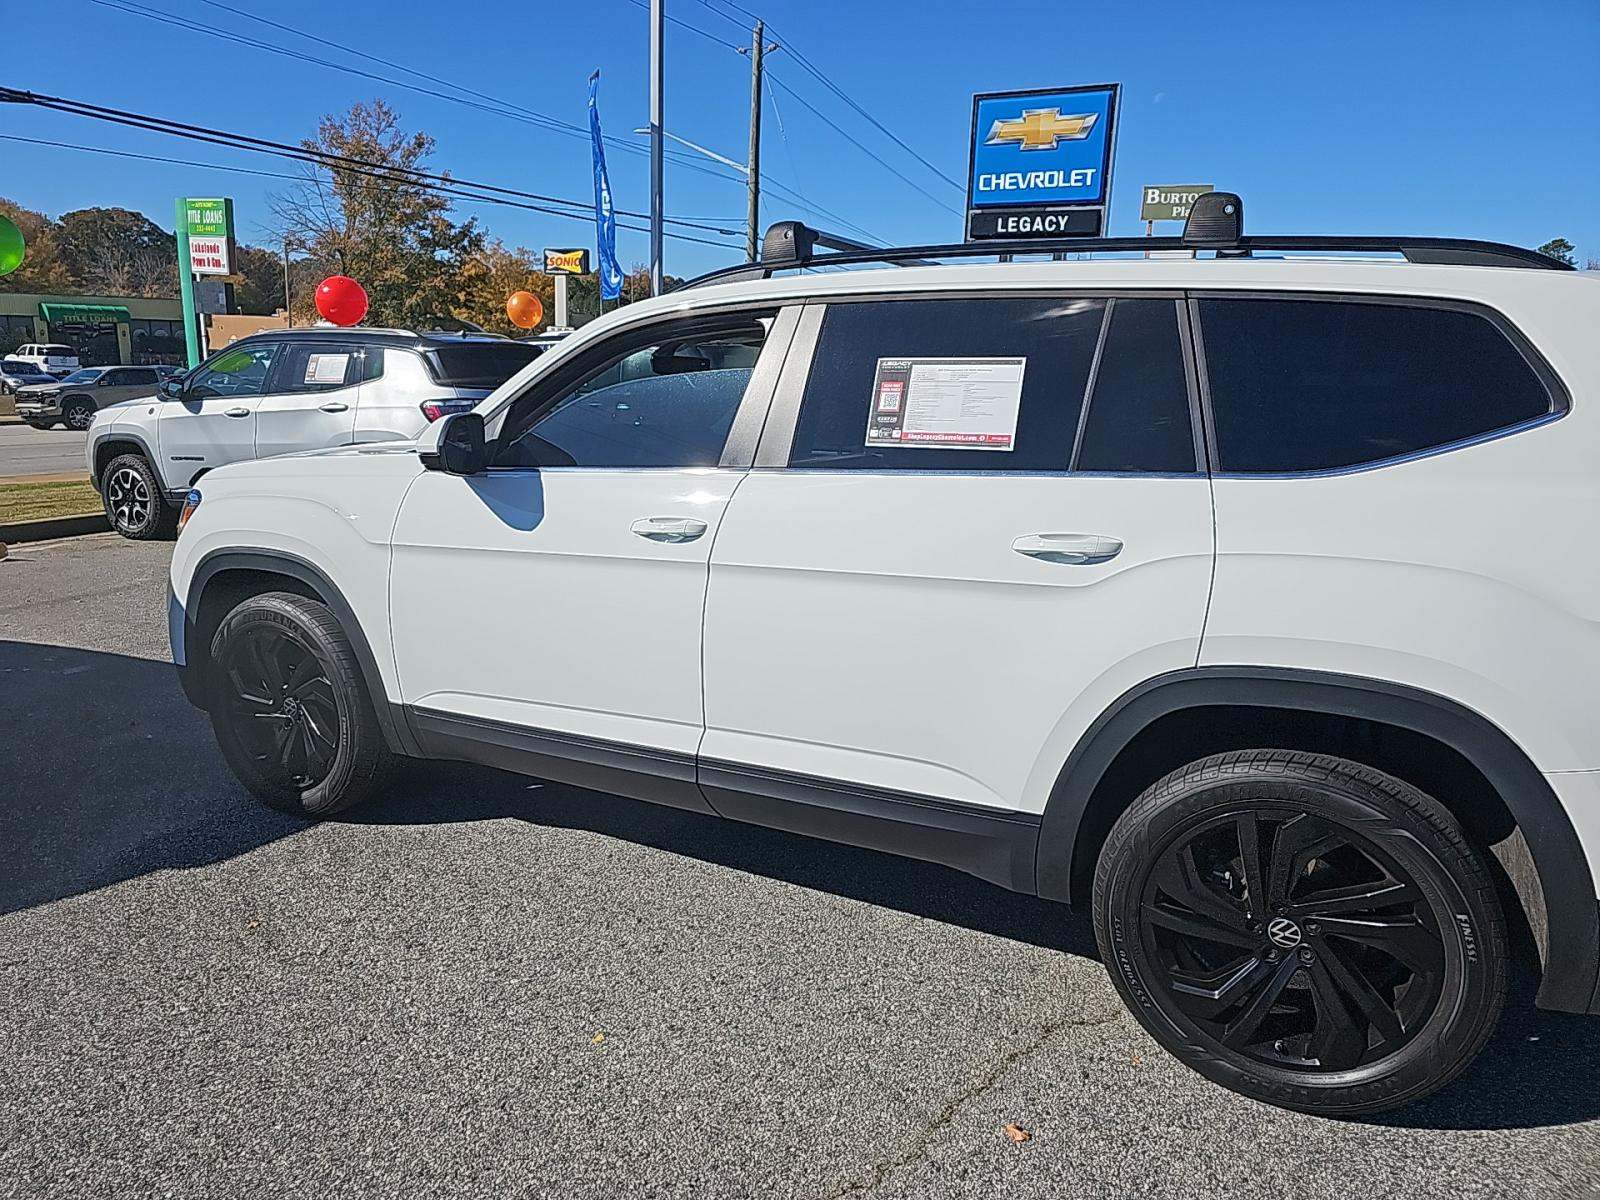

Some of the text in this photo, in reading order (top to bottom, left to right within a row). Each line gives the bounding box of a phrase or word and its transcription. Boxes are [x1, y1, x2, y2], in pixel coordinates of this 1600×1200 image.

[979, 169, 1096, 191] CHEVROLET
[1146, 188, 1202, 204] BURTO
[202, 209, 222, 224] LOANS
[997, 215, 1069, 232] LEGACY
[548, 256, 580, 266] SONIC
[63, 314, 118, 323] TITLE LOANS
